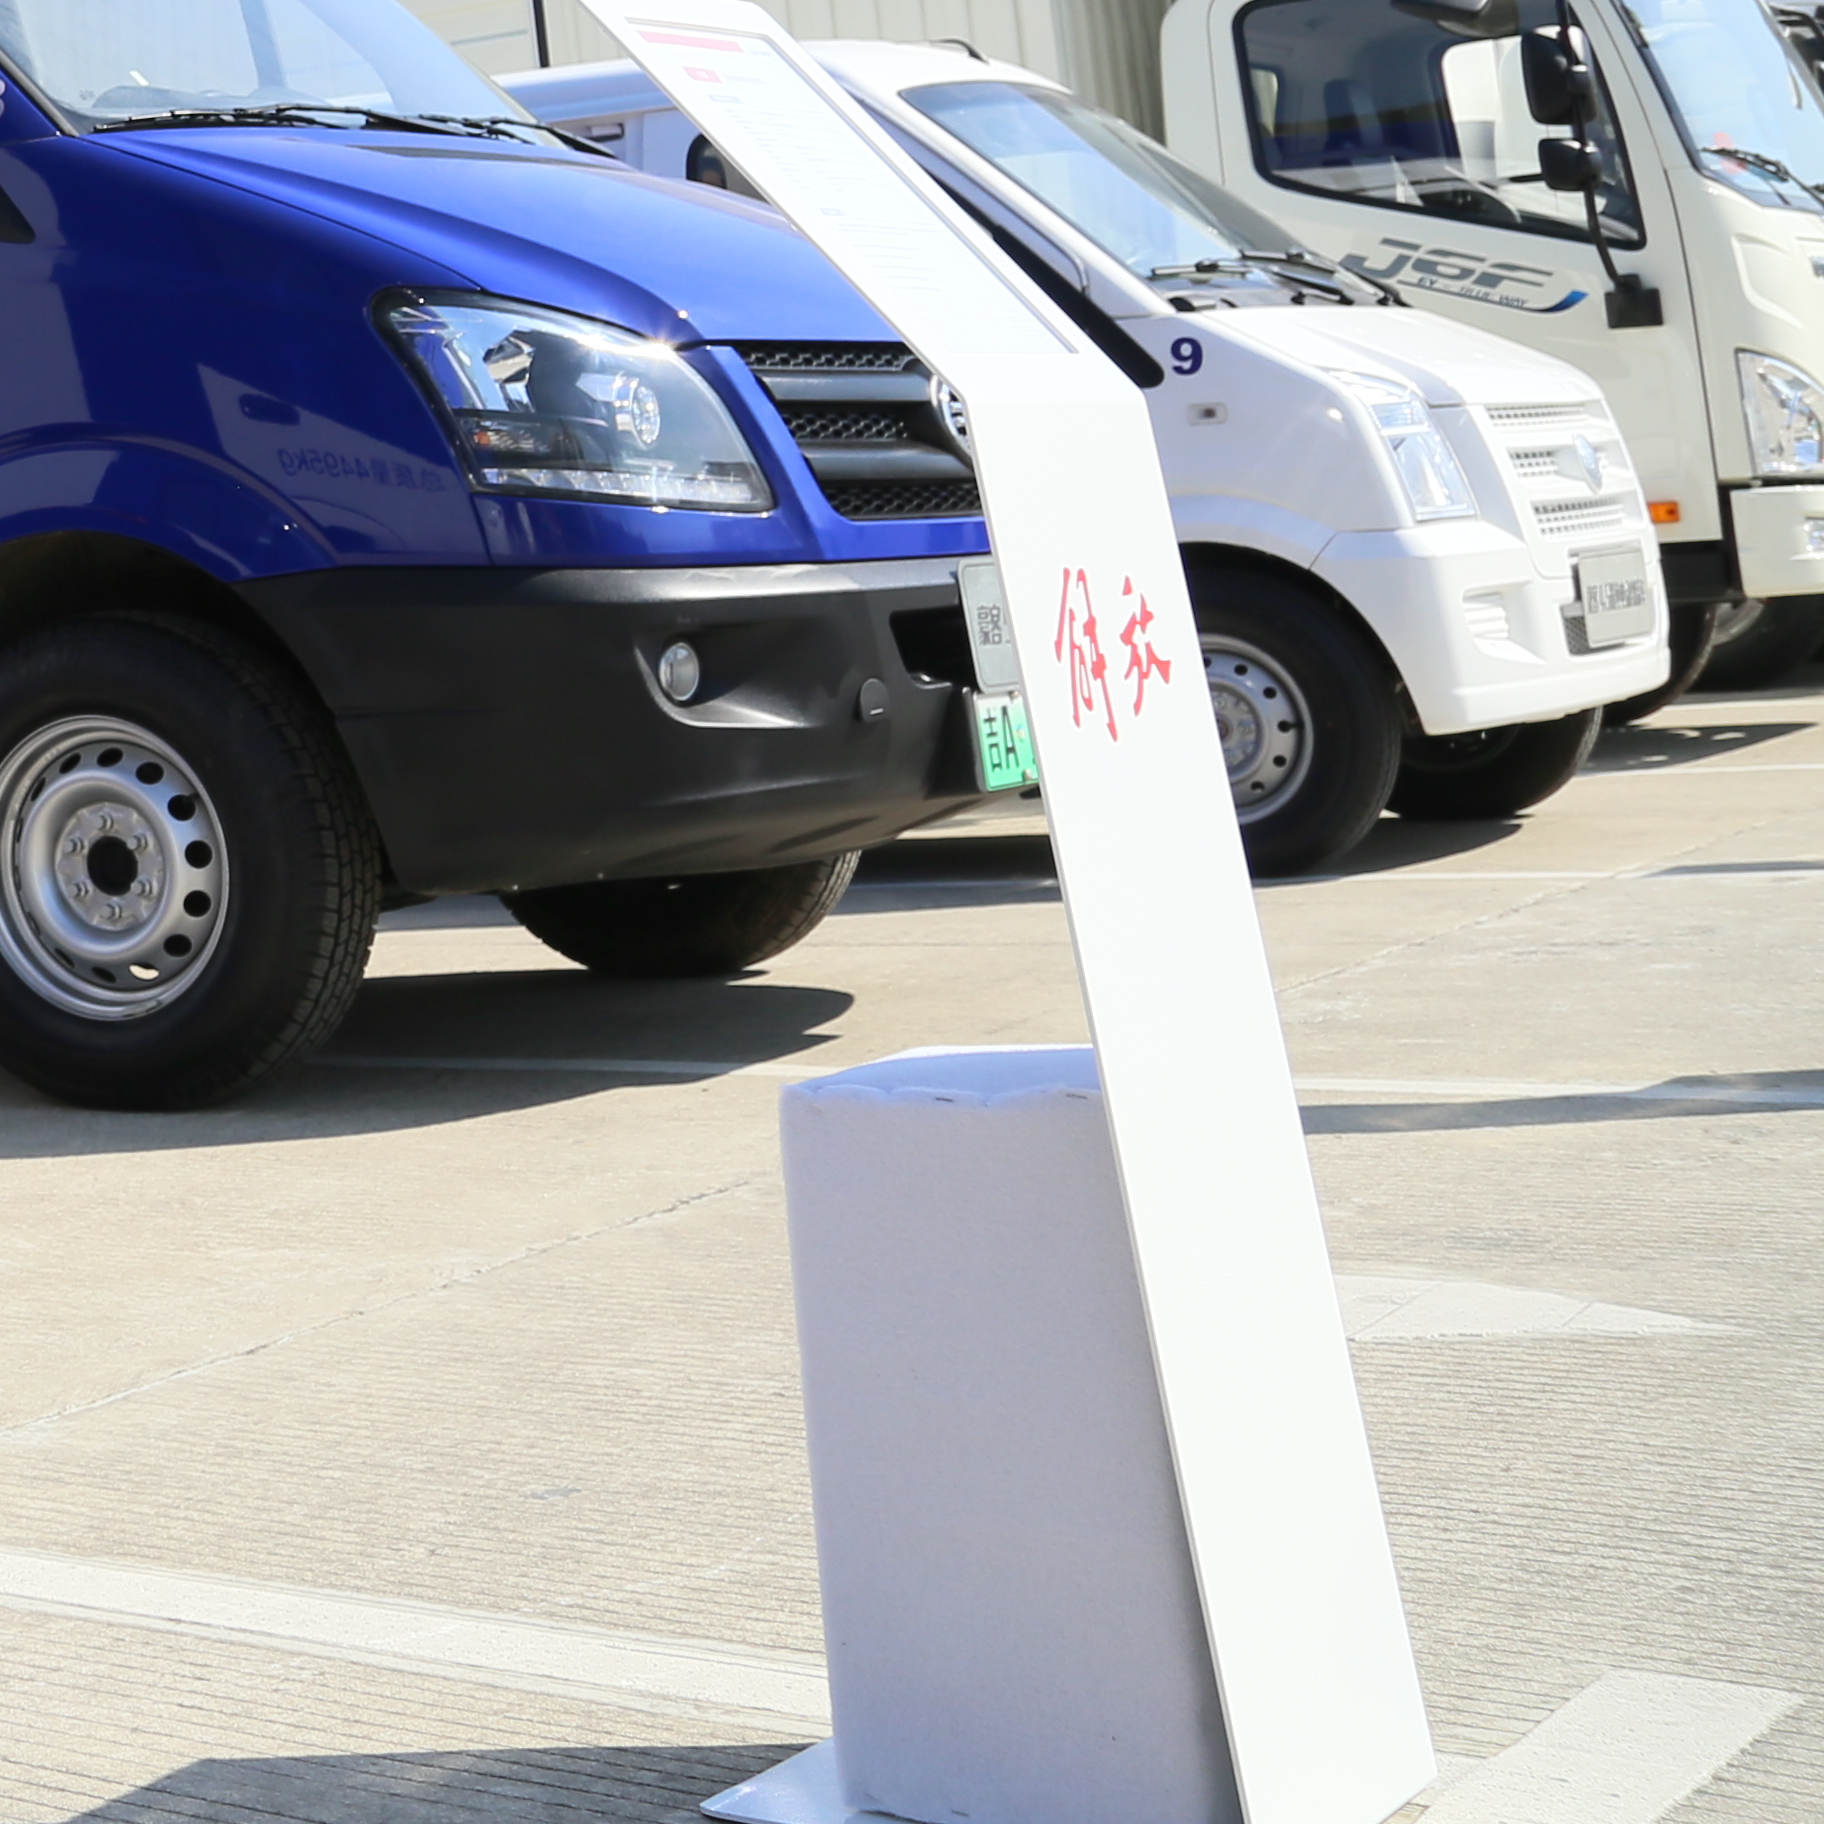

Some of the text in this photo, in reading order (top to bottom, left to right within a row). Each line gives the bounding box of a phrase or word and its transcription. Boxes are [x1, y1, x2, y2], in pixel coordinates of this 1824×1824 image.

[1339, 237, 1554, 288] J6F
[1170, 337, 1204, 375] 9
[976, 605, 1010, 646] 豪客
[983, 705, 1036, 773] 吉A
